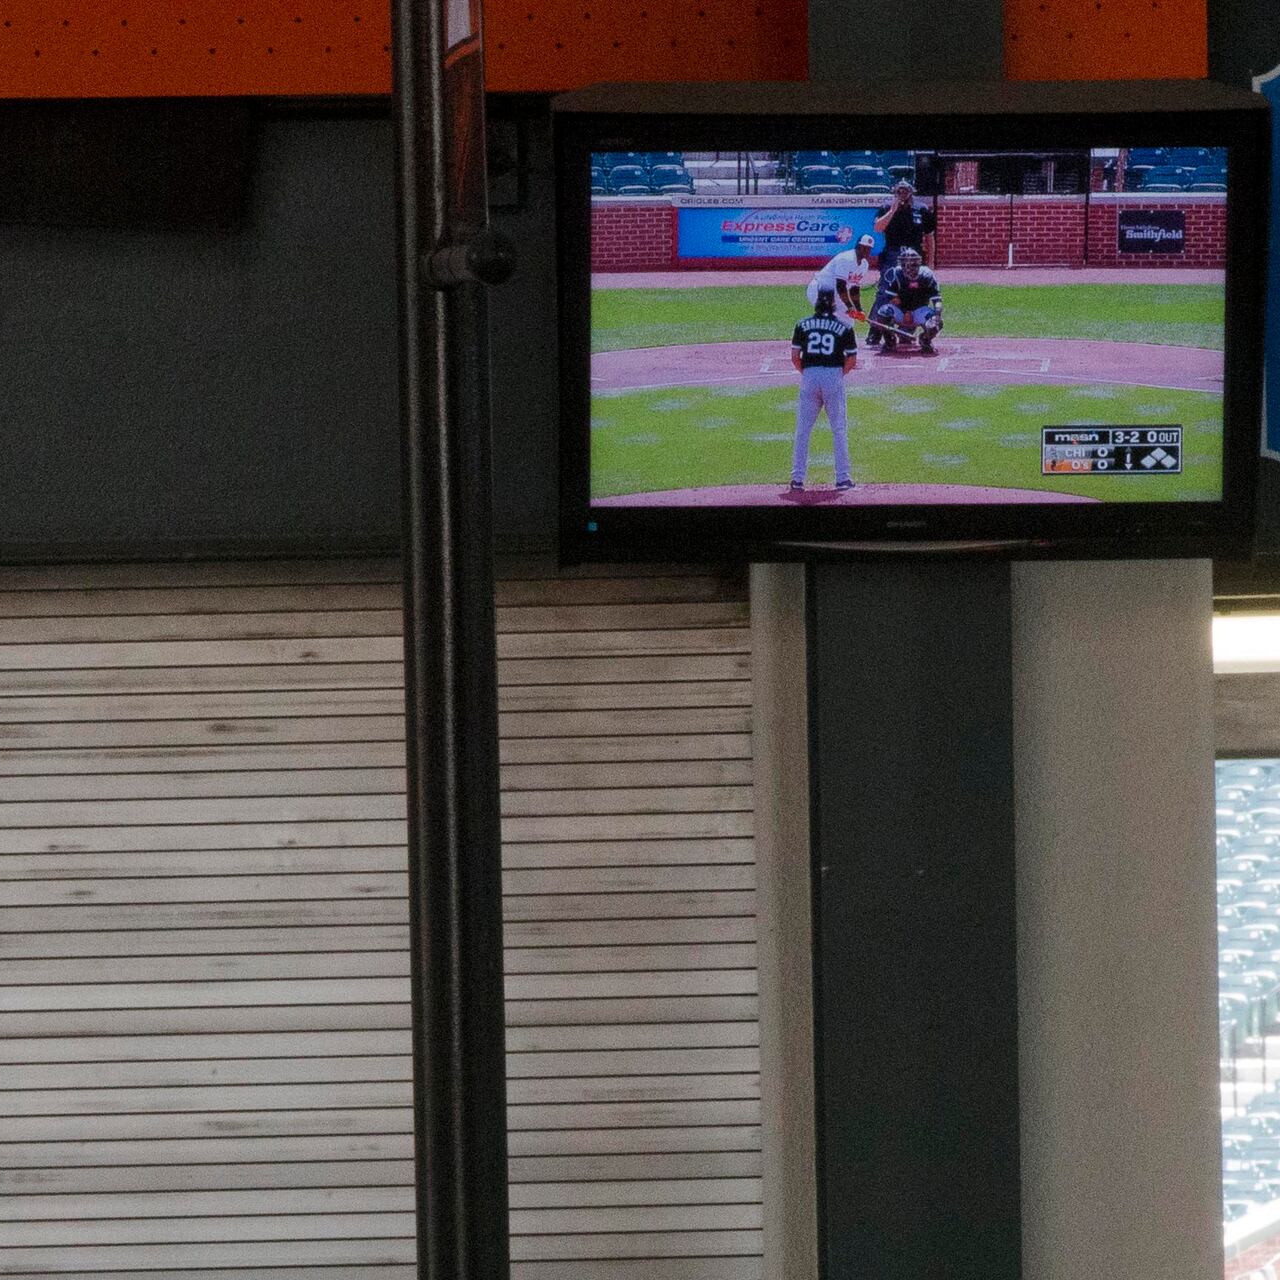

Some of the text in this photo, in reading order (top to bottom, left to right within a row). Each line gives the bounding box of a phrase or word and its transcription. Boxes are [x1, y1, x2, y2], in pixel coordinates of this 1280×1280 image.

[722, 219, 840, 234] ExpressCare
[1125, 229, 1183, 242] Smithfield
[807, 331, 835, 355] 29
[1114, 431, 1140, 443] 3-2
[1158, 432, 1179, 442] OUT
[1065, 448, 1086, 457] CHI
